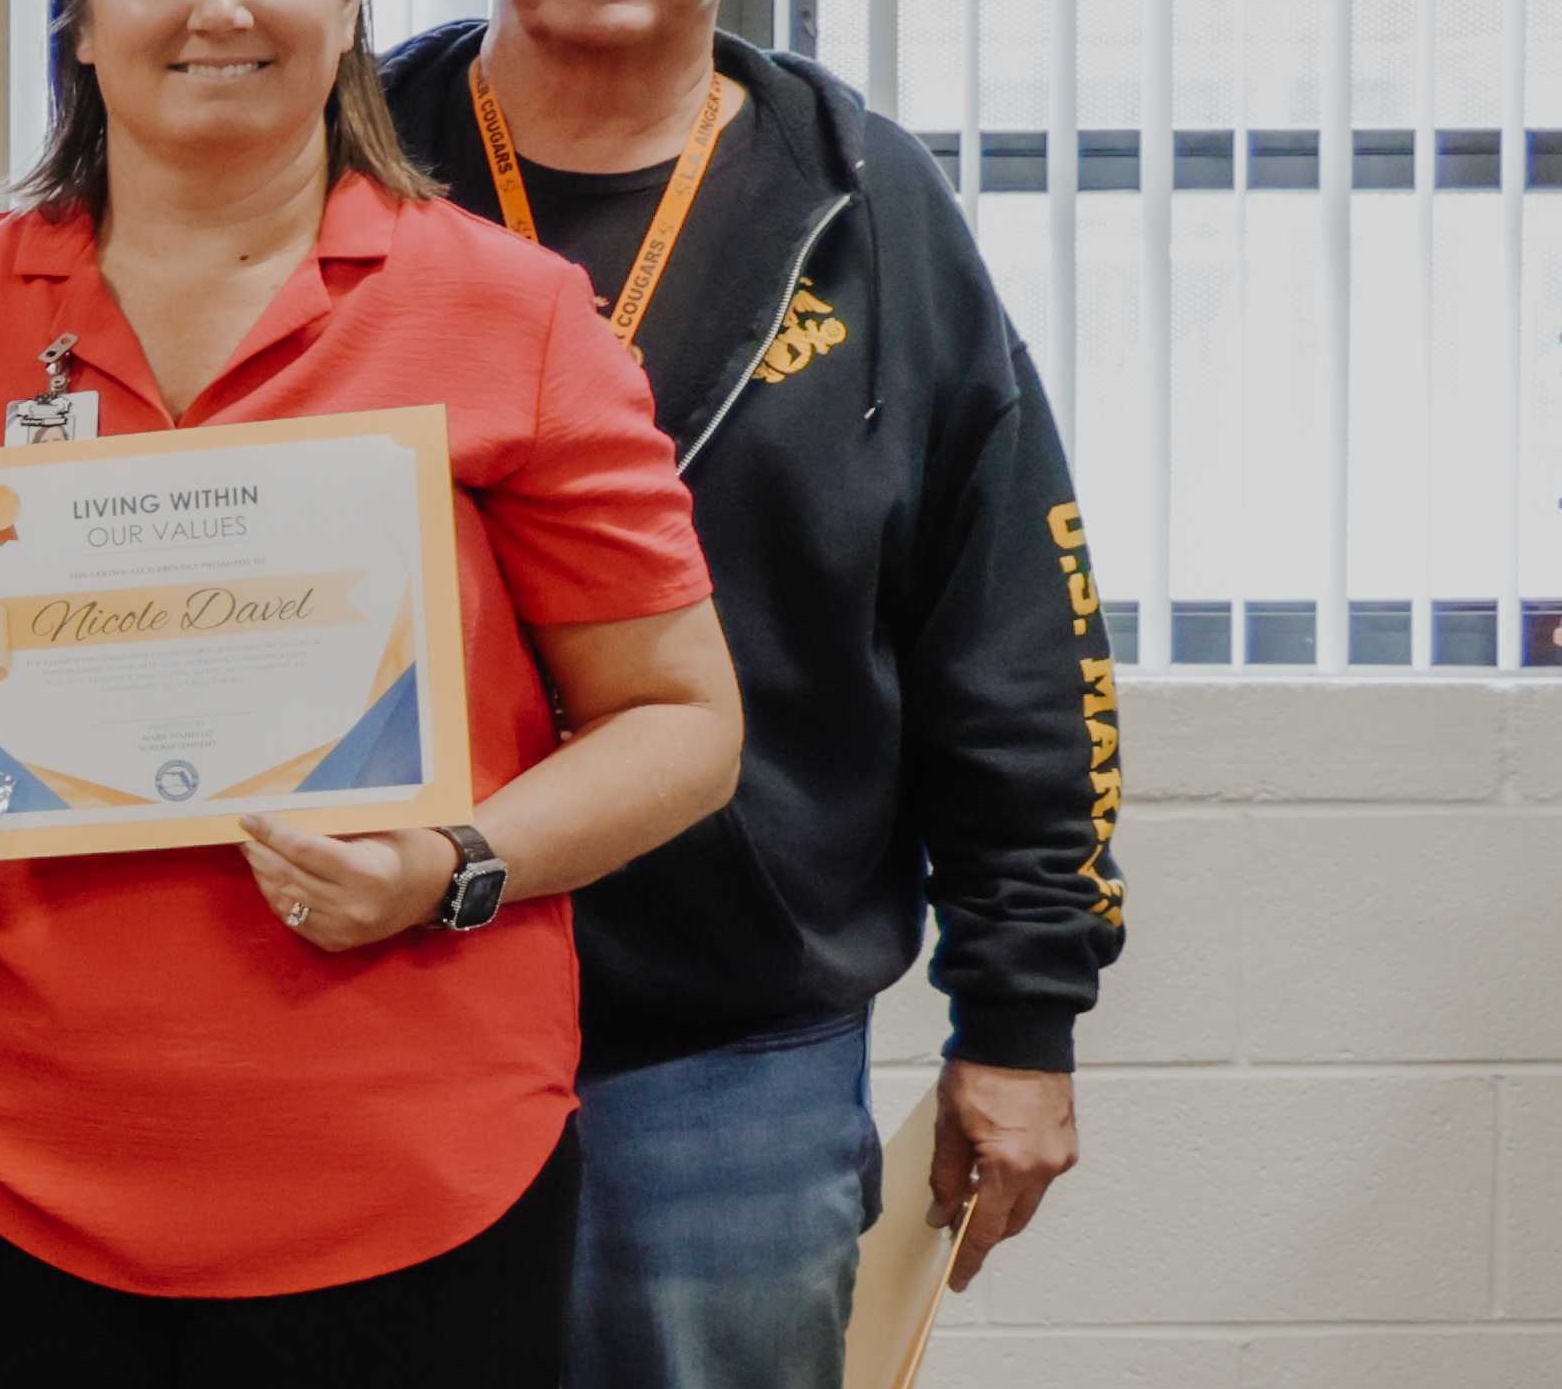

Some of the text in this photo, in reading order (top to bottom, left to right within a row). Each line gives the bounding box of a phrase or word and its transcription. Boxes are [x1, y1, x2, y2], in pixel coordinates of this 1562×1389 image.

[480, 99, 513, 175] COUGARS
[616, 239, 665, 328] COUGARS
[73, 485, 259, 519] LIVING WITHIN
[87, 515, 248, 548] OUR VALUES
[31, 587, 315, 642] Nicole Davel
